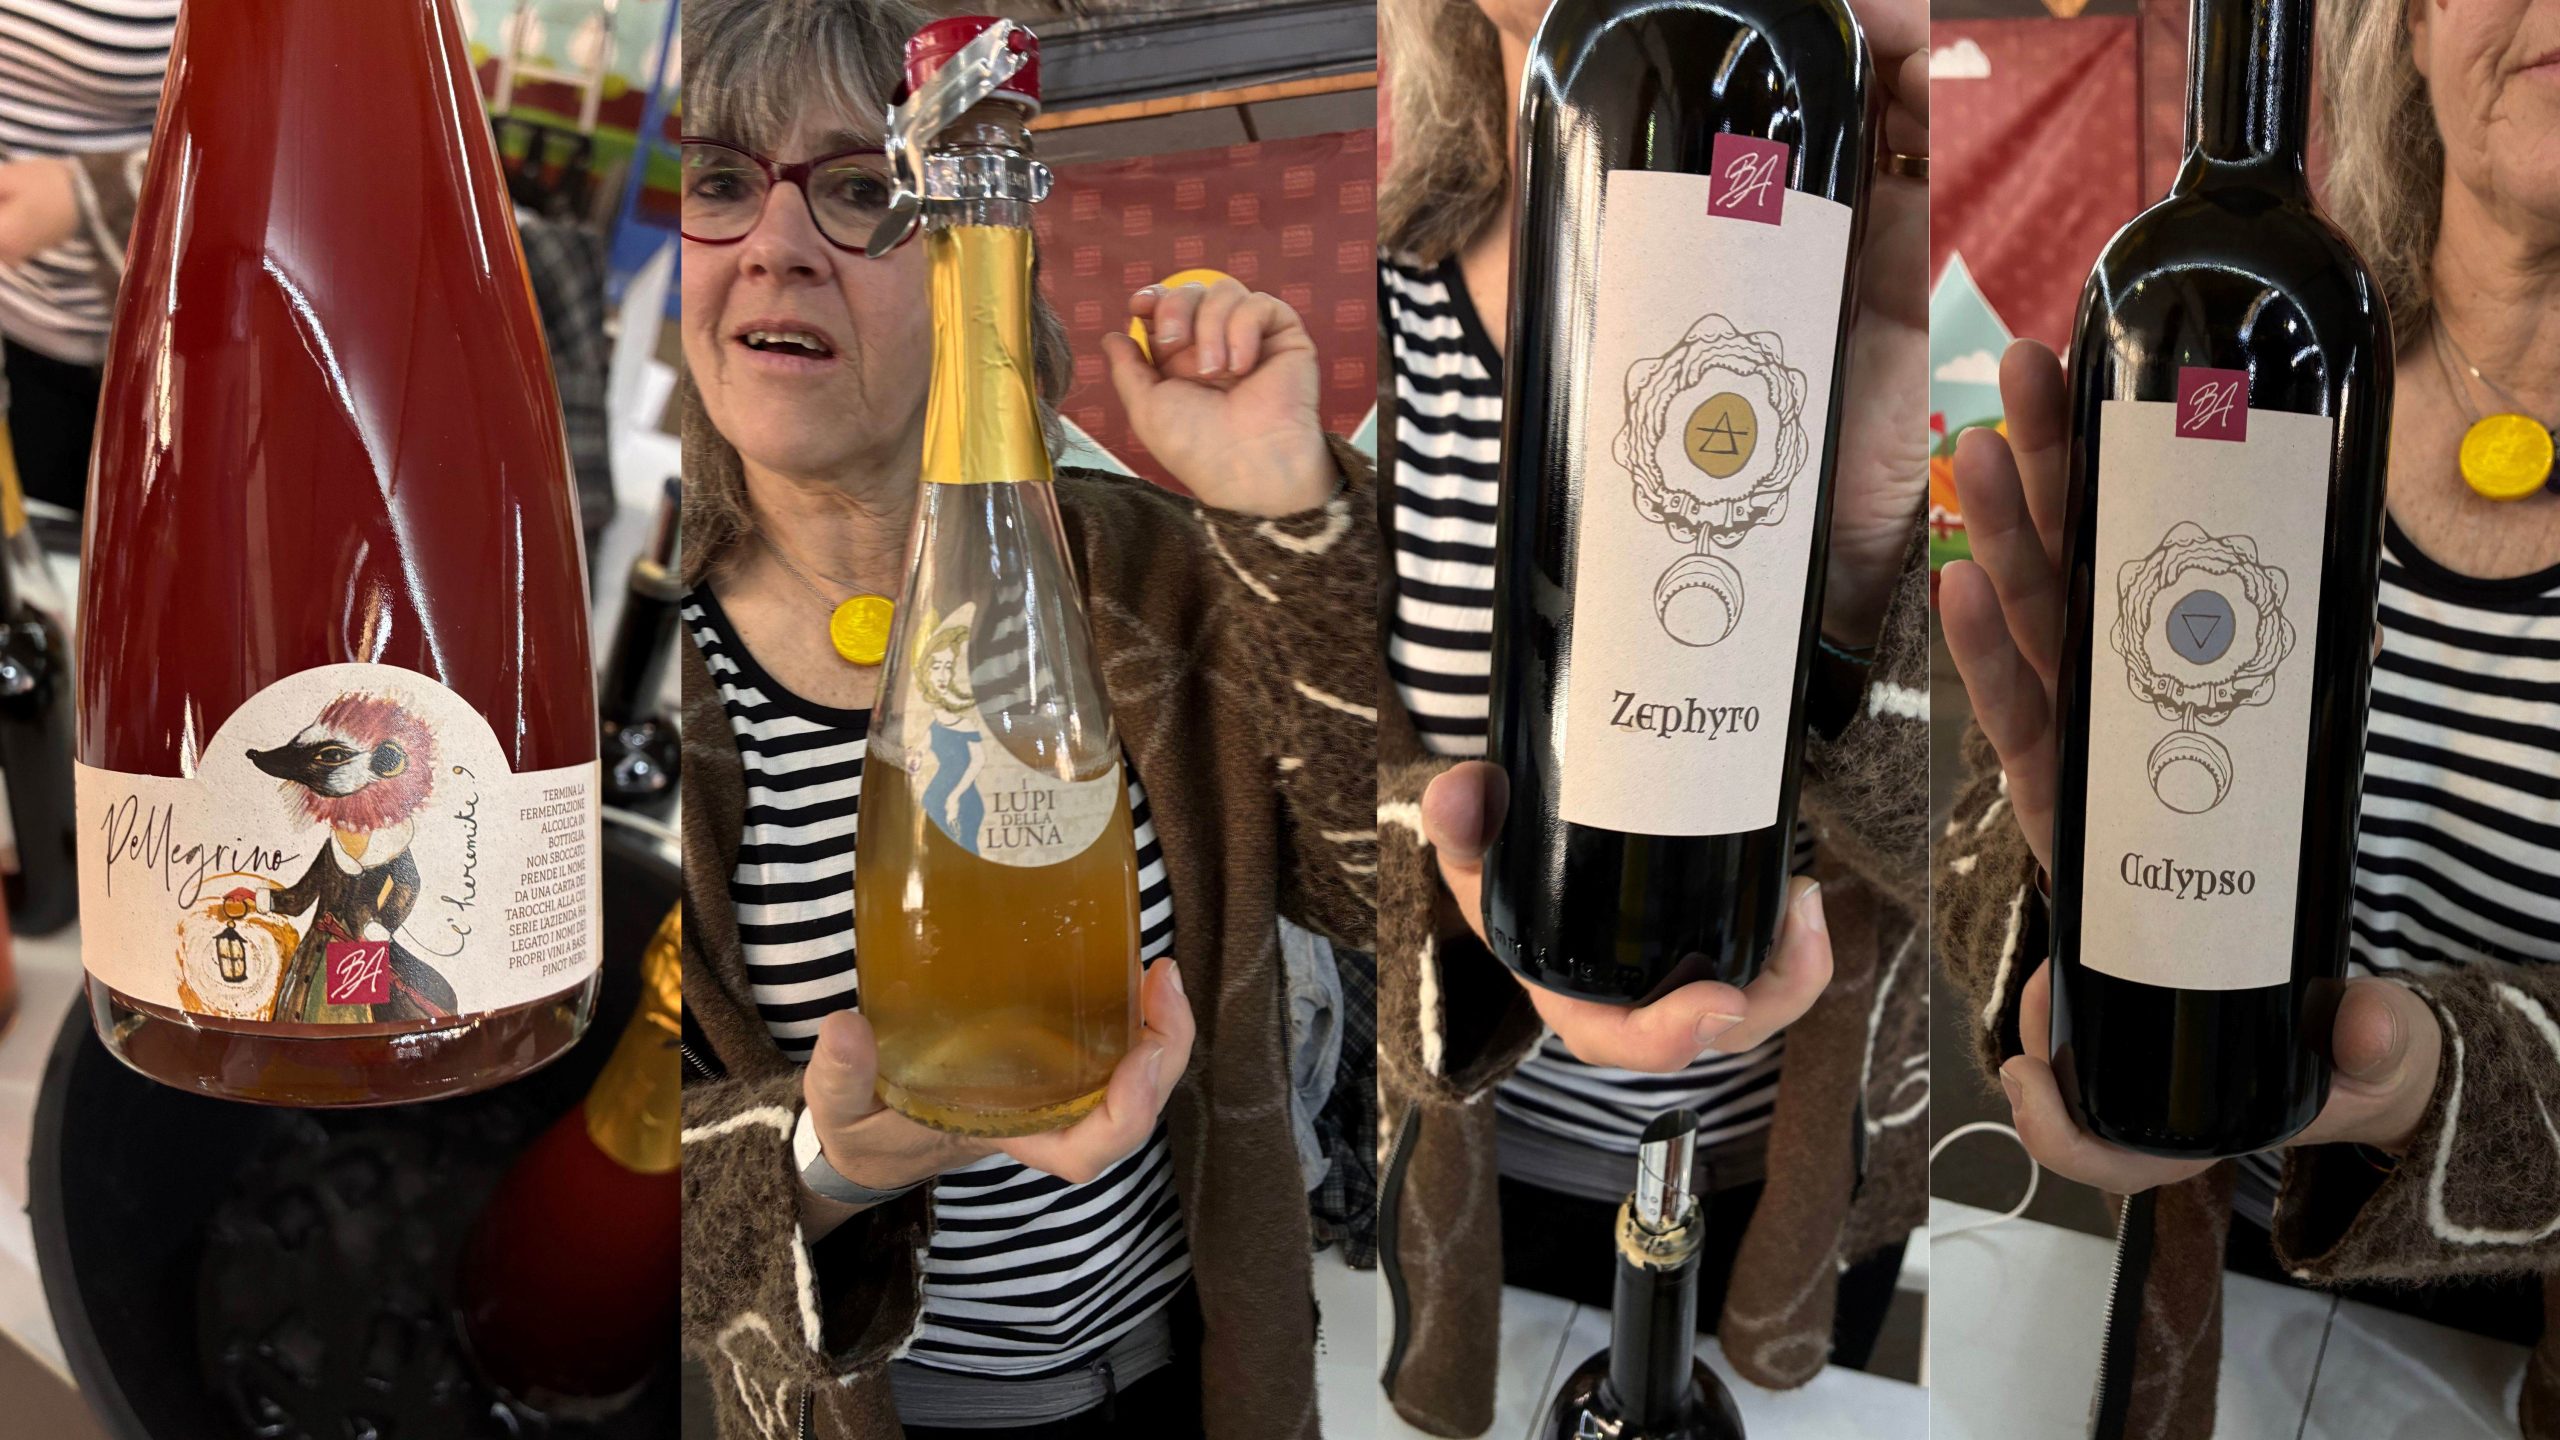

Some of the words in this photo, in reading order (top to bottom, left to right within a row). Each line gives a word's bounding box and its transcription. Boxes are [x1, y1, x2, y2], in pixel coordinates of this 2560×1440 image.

[1610, 689, 1760, 741] Zephyro
[543, 785, 577, 802] TERMINA
[578, 783, 585, 795] LA
[993, 789, 1055, 813] LUPI
[520, 798, 585, 821] FERMENTAZIONE
[1001, 812, 1052, 827] DELLA
[541, 816, 577, 834] ALCOLICA
[578, 813, 585, 826] IN
[986, 824, 1064, 849] LUNA
[101, 795, 300, 910] Pellegrino
[526, 853, 548, 869] NON
[521, 867, 558, 886] PRENDE
[559, 865, 567, 878] IL
[567, 858, 586, 875] NOME
[2120, 852, 2256, 901] Calypso
[515, 890, 529, 903] DA
[531, 885, 551, 900] UNA
[552, 877, 576, 895] CARTA
[576, 873, 586, 888] DEI
[557, 892, 575, 910] ALLA
[576, 888, 586, 902] CUI
[509, 919, 538, 937] SERIE
[540, 908, 577, 931] L'AZIENDA
[578, 904, 586, 917] HA
[512, 933, 549, 953] LEGATO
[556, 924, 576, 942] NOMI
[576, 919, 586, 934] DEI
[509, 950, 545, 969] PROPRI
[547, 942, 565, 960] VINI
[565, 941, 571, 954] A
[572, 933, 586, 950] BASE
[542, 957, 568, 977] PINOT
